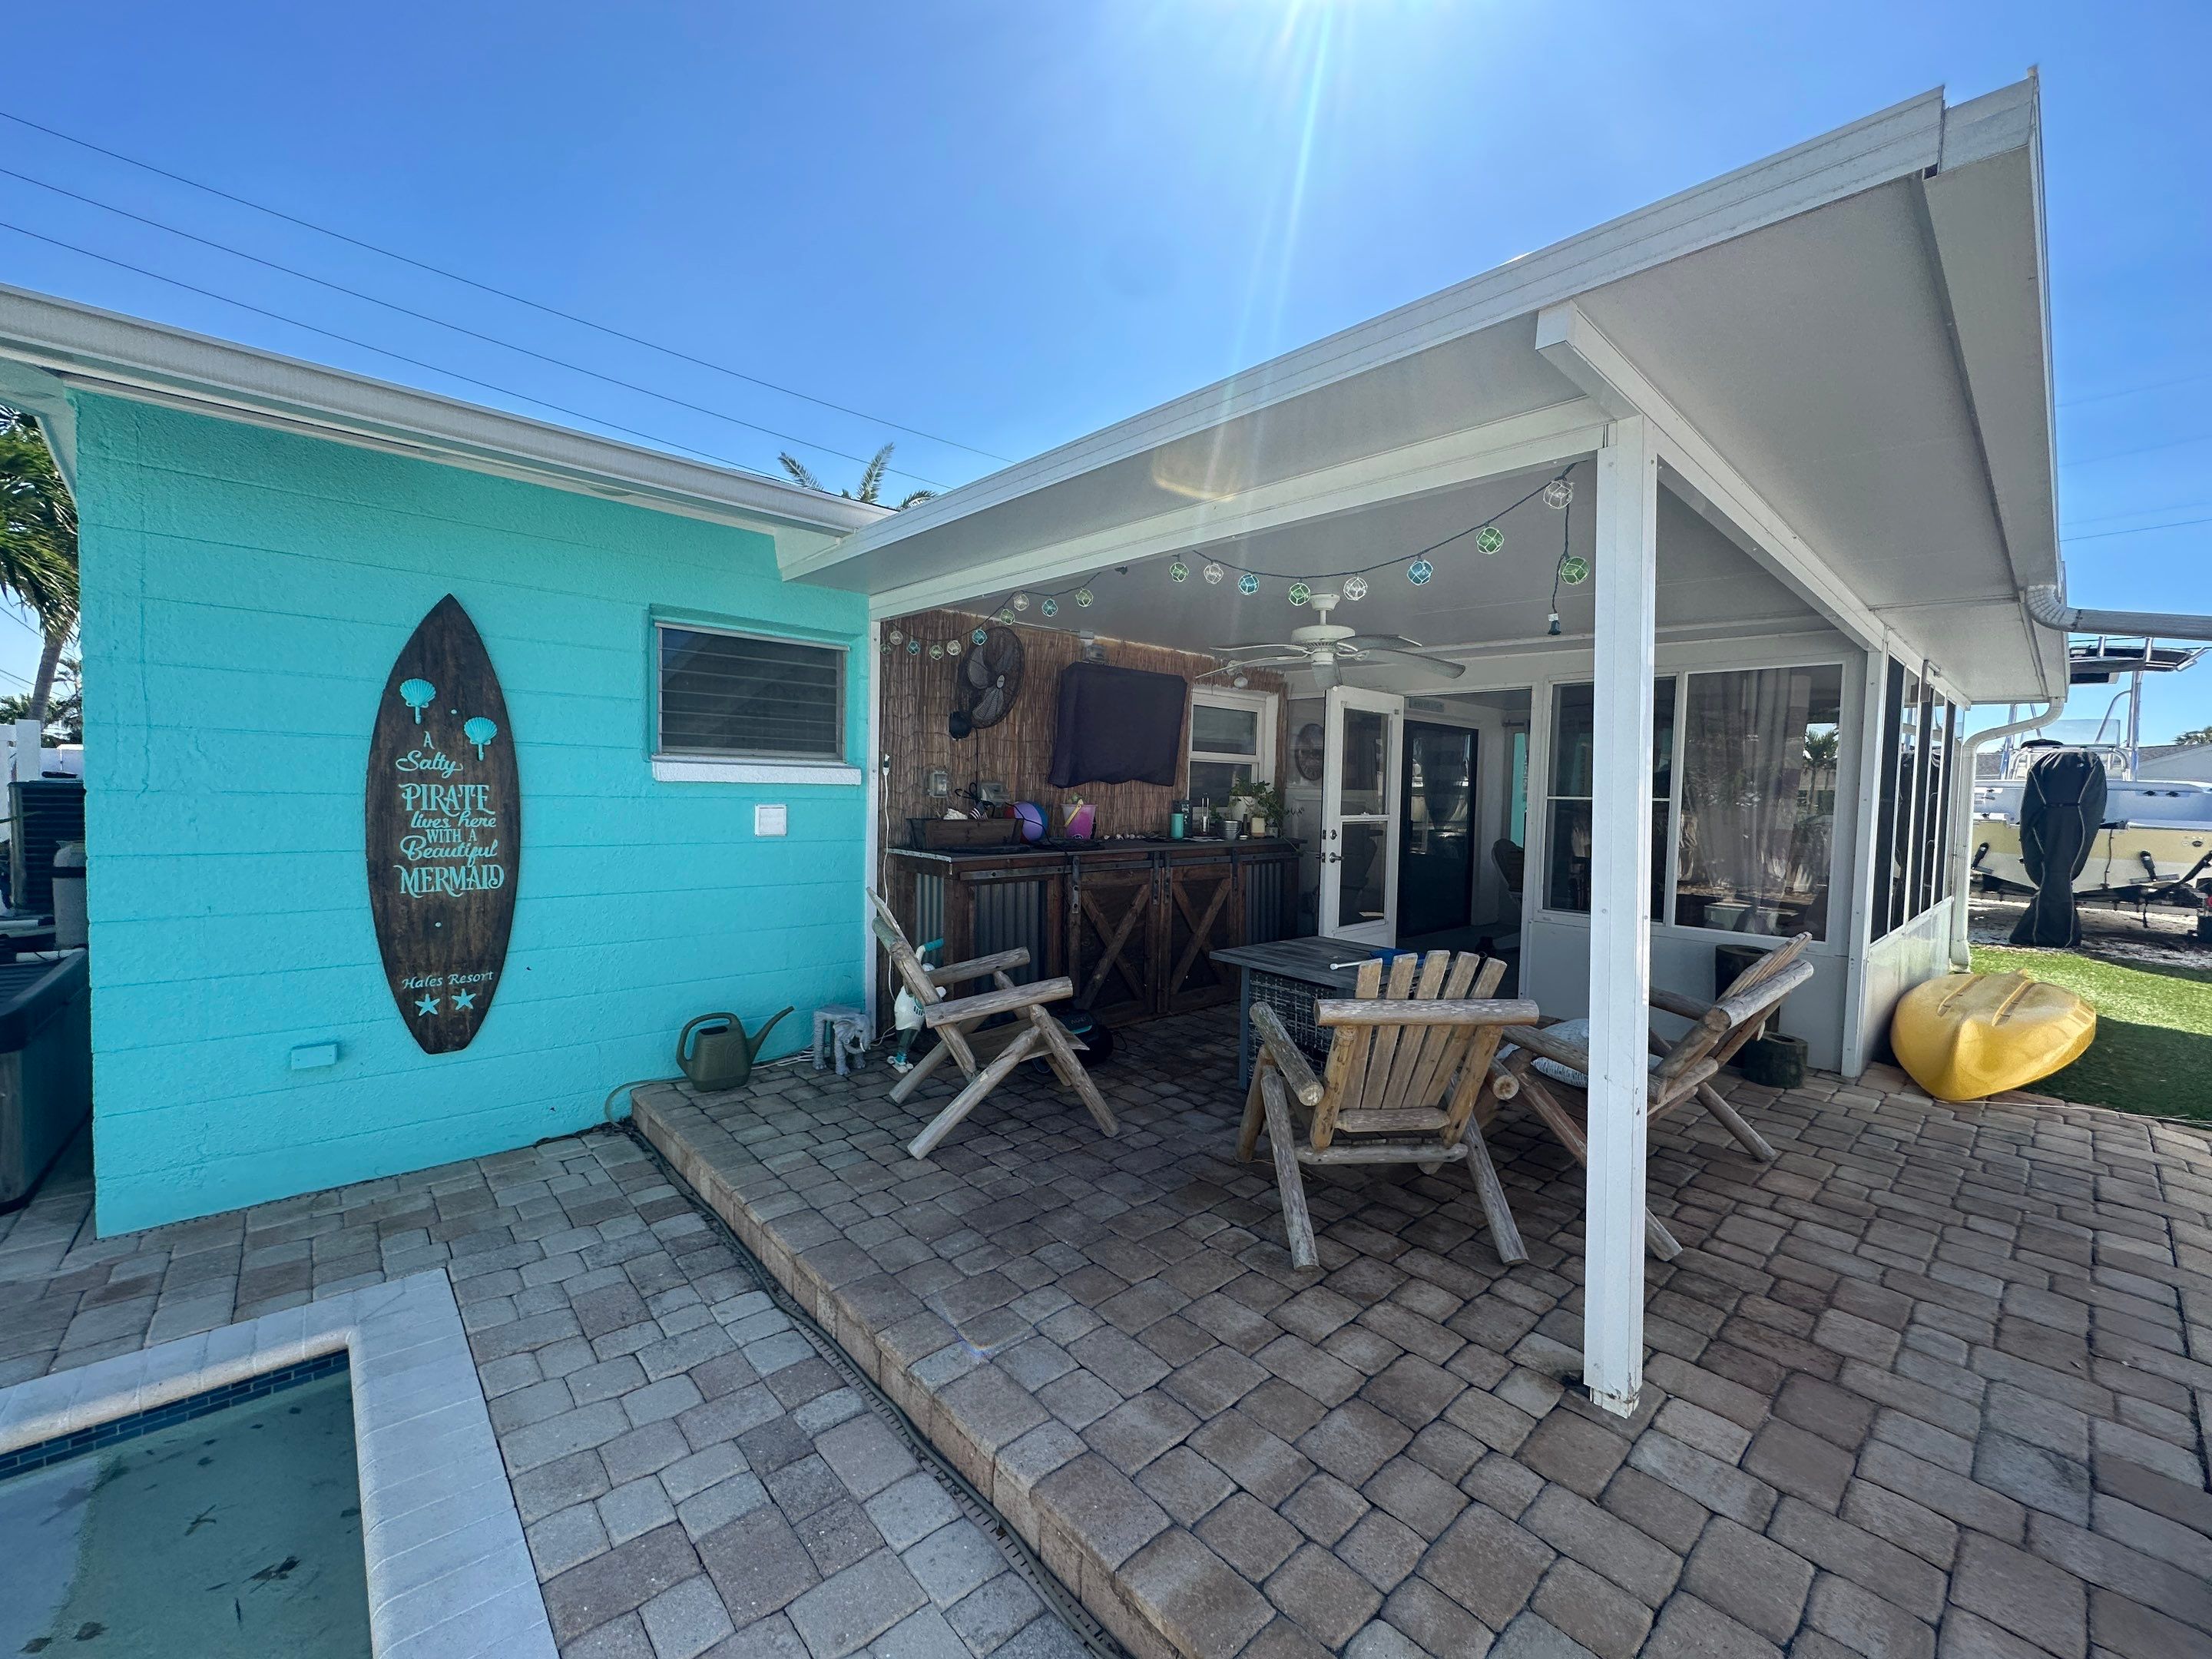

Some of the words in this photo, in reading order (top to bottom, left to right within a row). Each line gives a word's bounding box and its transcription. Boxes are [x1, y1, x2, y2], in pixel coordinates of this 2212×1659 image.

[423, 730, 435, 750] A
[396, 750, 464, 779] Salty
[398, 783, 495, 817] PIRATE
[410, 810, 452, 829] lives
[458, 810, 497, 828] here
[426, 829, 462, 844] WITH
[468, 829, 478, 842] A
[399, 835, 498, 868] Beautiful
[392, 864, 505, 899] MERMAID
[401, 975, 443, 990] Hales
[447, 970, 494, 986] Resort
